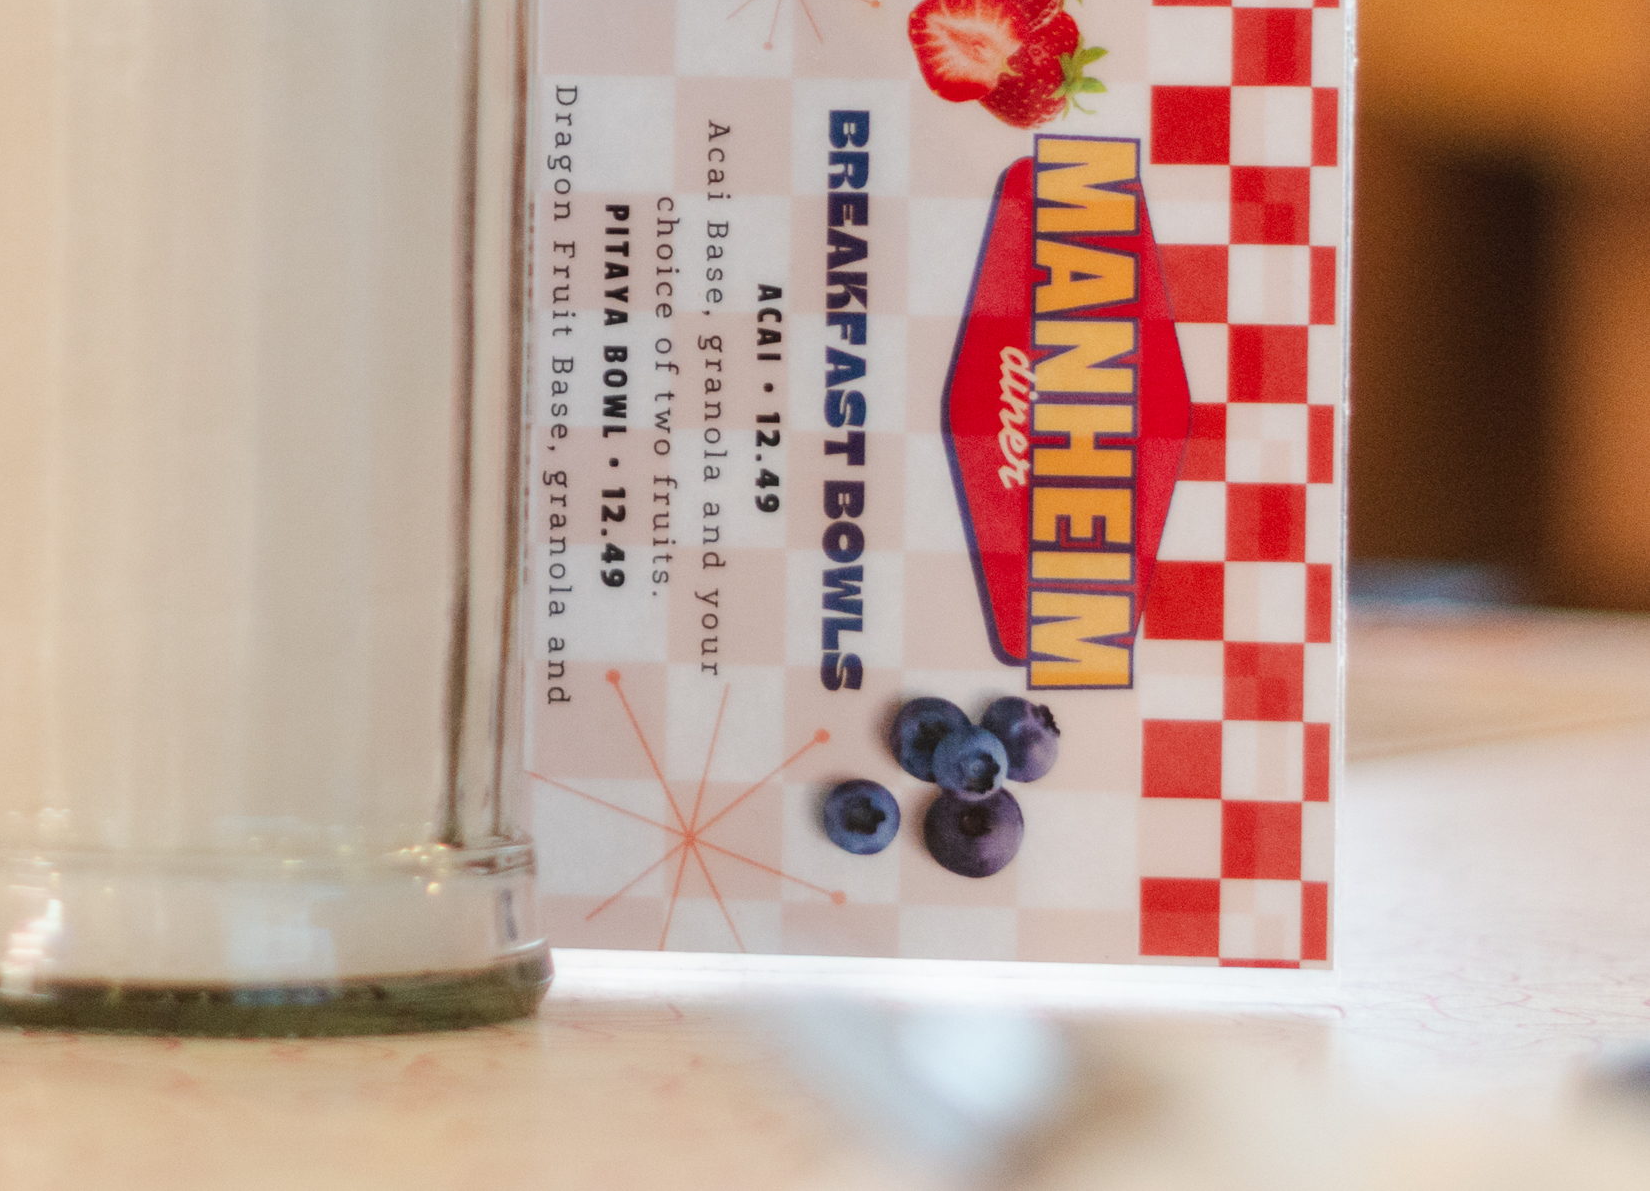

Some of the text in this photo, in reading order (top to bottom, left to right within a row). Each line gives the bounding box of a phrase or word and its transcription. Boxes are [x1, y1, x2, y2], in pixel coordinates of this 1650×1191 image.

[543, 85, 577, 705] Dragon Fruit Base, granola and
[601, 204, 630, 587] PITAYA BOWL 12.49
[653, 196, 680, 597] choice of two fruits.
[695, 120, 731, 676] Acai Base, granola and your
[755, 283, 782, 513] ACAI 12.49
[820, 110, 870, 692] BREAKFAST BOWLS
[998, 346, 1038, 489] diner
[1028, 135, 1140, 690] MANHEIM
